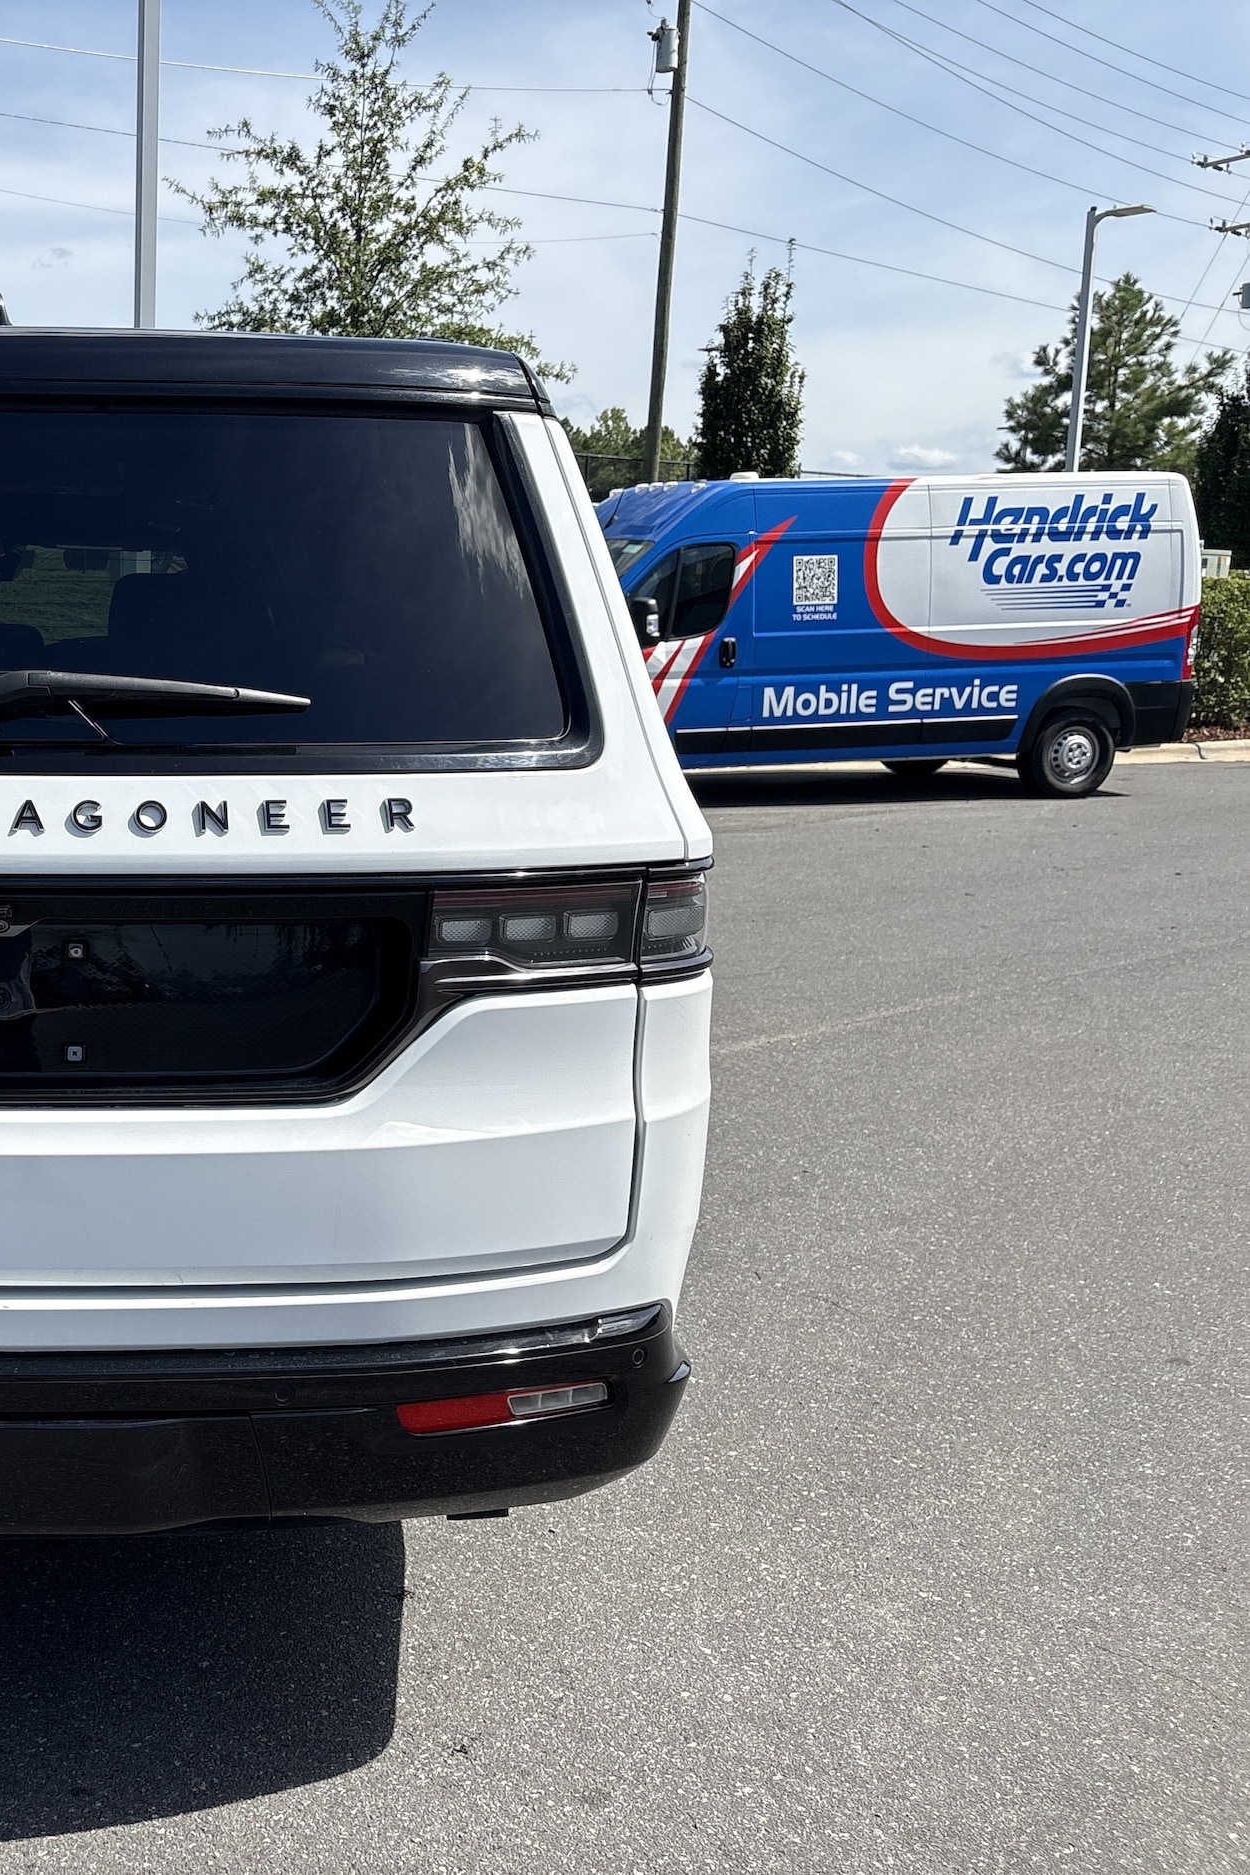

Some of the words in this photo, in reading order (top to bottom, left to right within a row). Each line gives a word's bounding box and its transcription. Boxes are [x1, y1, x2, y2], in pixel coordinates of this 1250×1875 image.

[949, 492, 1158, 562] Hendrick
[982, 546, 1142, 585] Cars.com
[803, 612, 837, 620] SCHEDULE
[762, 683, 877, 717] Mobile
[888, 679, 1018, 713] Service
